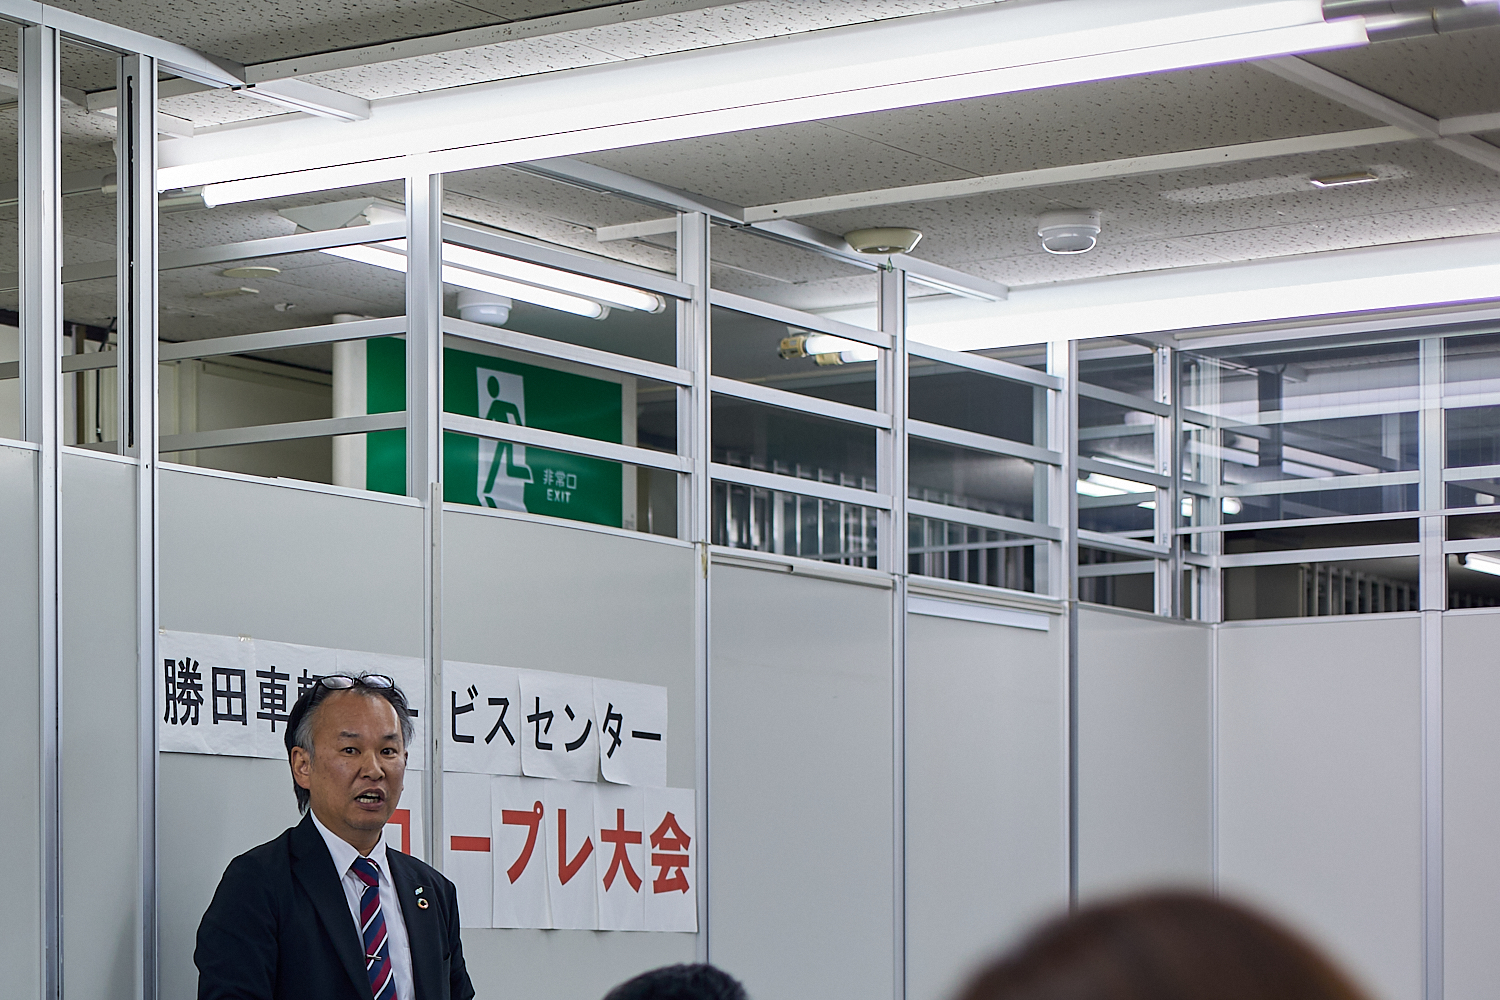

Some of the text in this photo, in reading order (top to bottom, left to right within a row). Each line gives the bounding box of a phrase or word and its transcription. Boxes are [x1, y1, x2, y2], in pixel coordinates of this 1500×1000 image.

[543, 468, 577, 489] 非常口
[546, 488, 572, 504] EXIT
